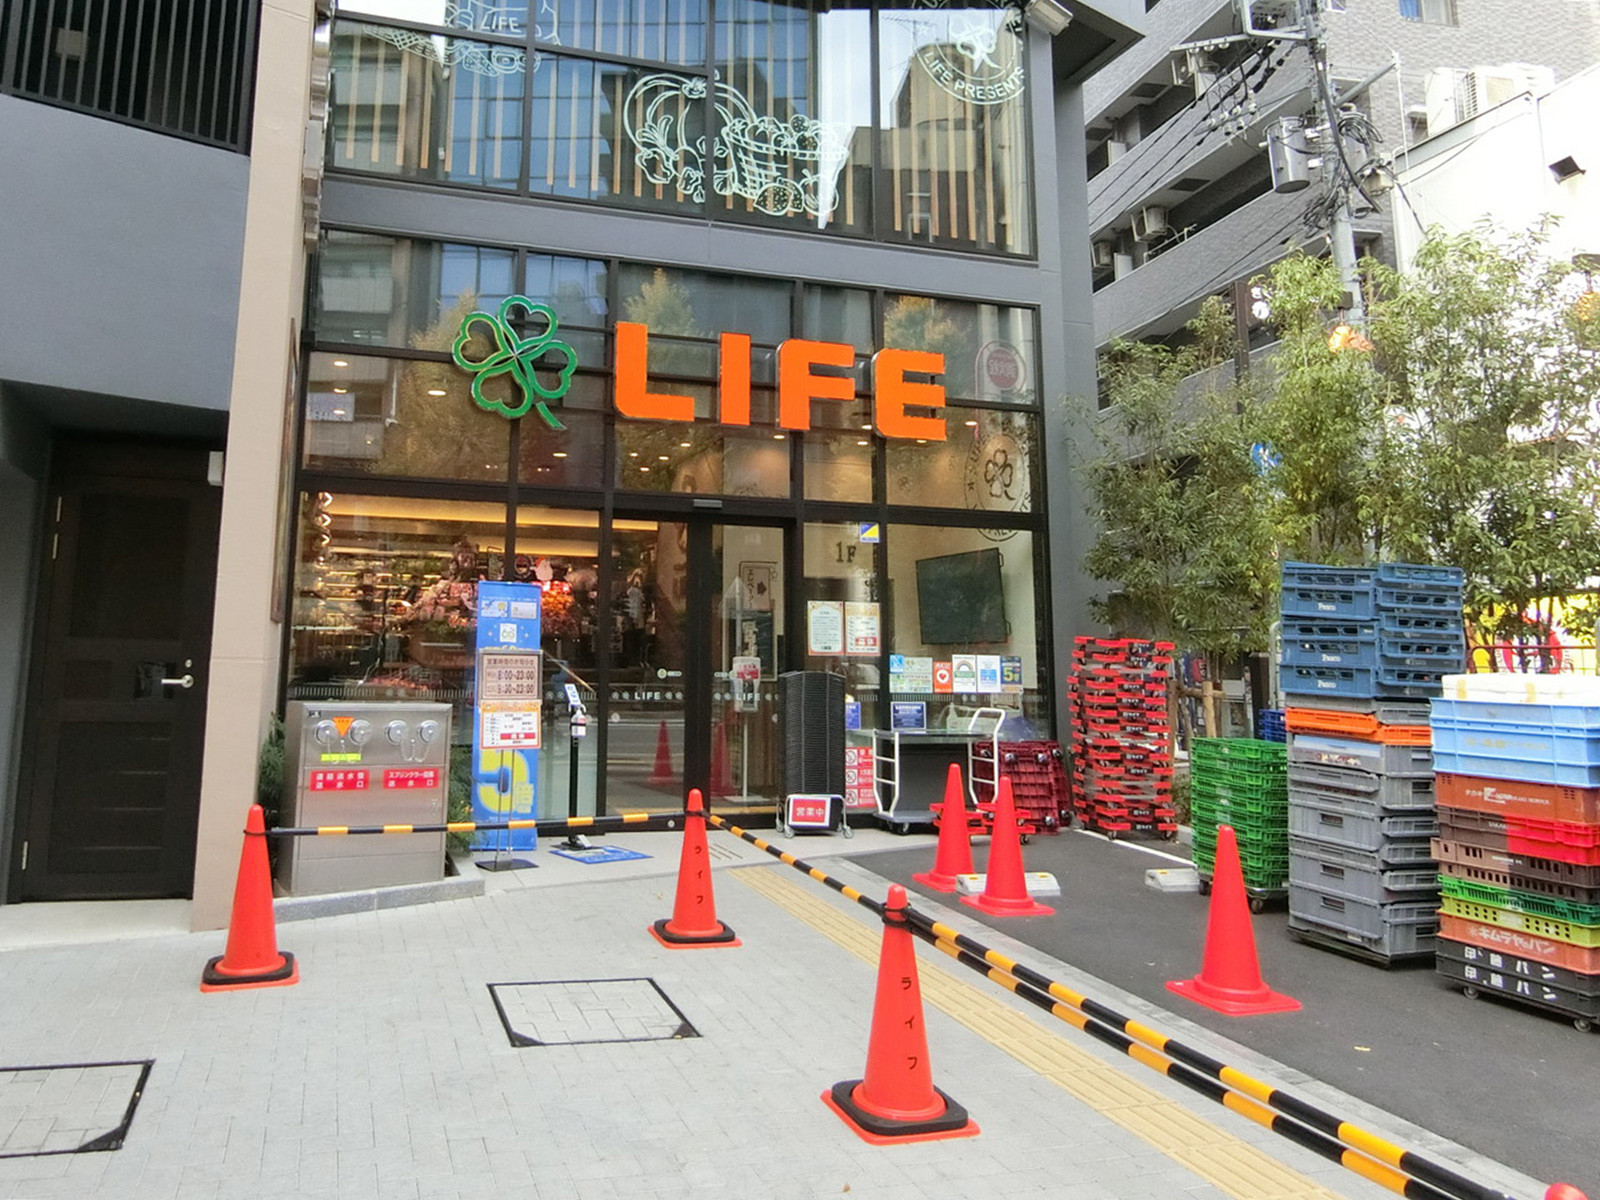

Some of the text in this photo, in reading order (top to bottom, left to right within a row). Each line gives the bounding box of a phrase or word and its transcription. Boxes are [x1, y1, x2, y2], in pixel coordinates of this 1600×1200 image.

[480, 14, 522, 34] LIFE
[923, 50, 1025, 101] LIFE PRESENTS
[613, 320, 948, 441] LIFE
[835, 540, 858, 564] 1F
[634, 691, 661, 701] LIFE
[735, 692, 761, 702] LIFE
[796, 806, 824, 818] 営業中
[901, 976, 918, 1070] ライフ
